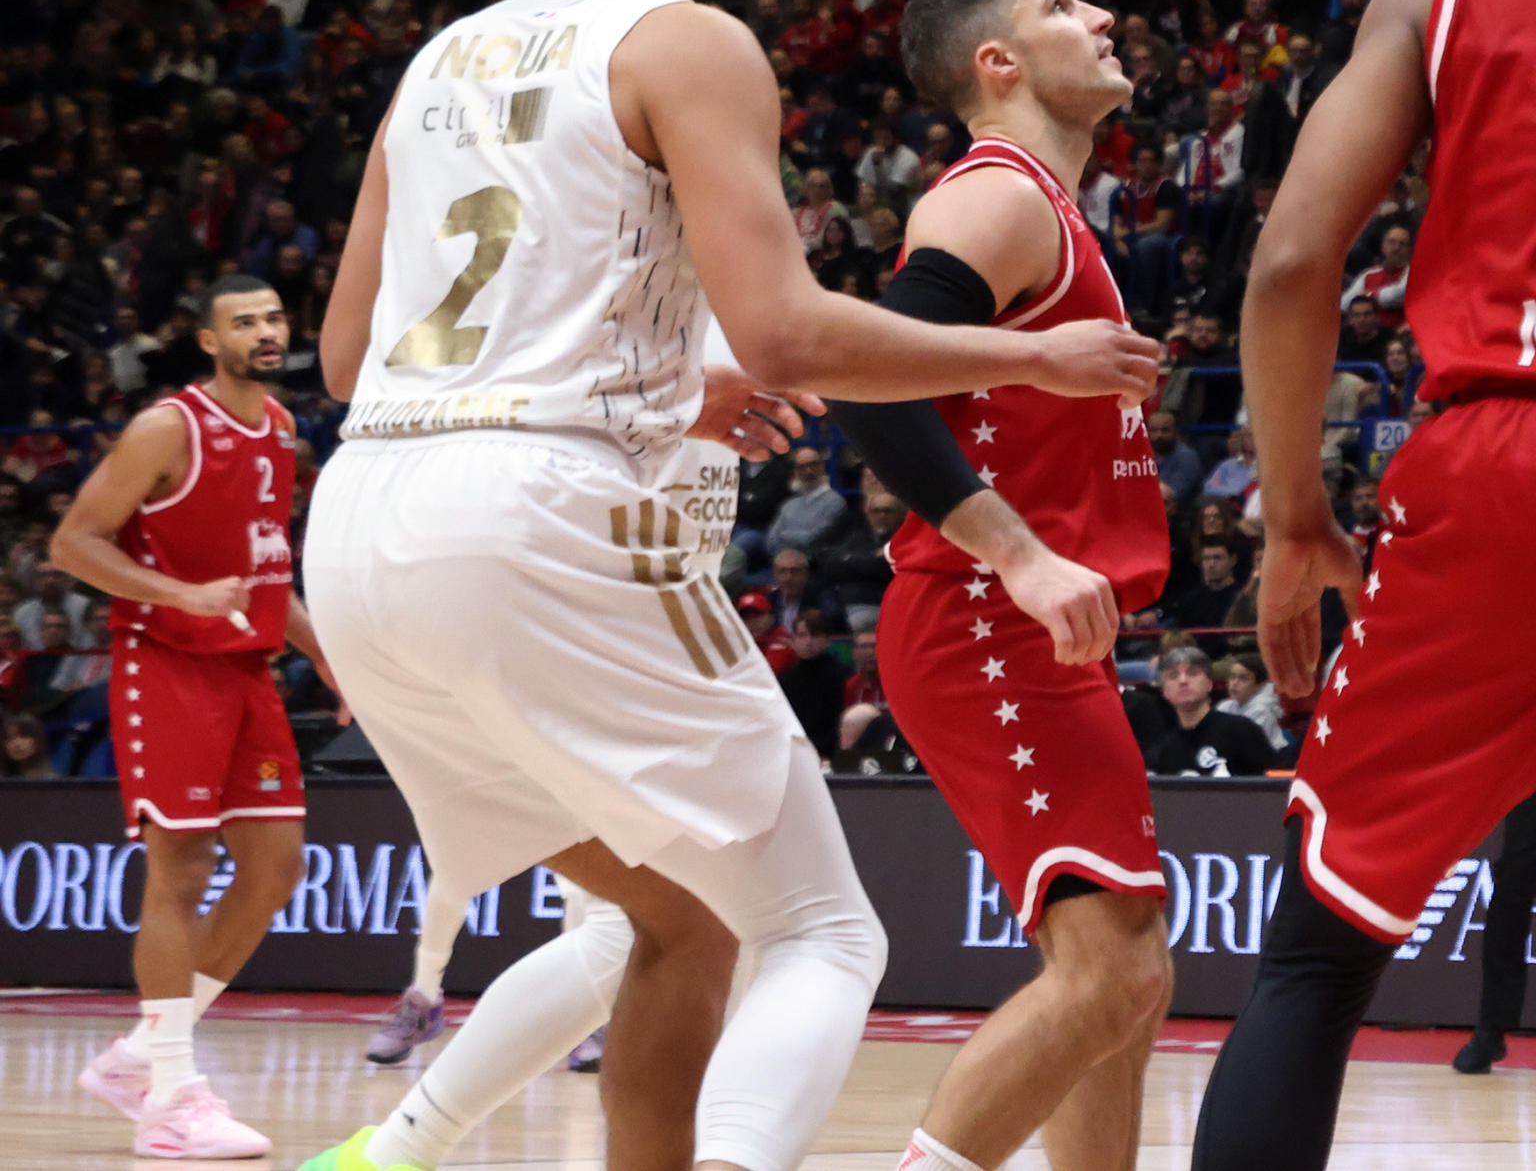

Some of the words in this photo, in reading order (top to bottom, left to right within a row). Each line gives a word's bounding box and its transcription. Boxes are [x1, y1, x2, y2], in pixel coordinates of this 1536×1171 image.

[429, 24, 578, 80] NOUA
[384, 185, 523, 368] 2
[1381, 425, 1405, 446] 20
[255, 455, 276, 504] 2
[0, 841, 148, 930] ORIO
